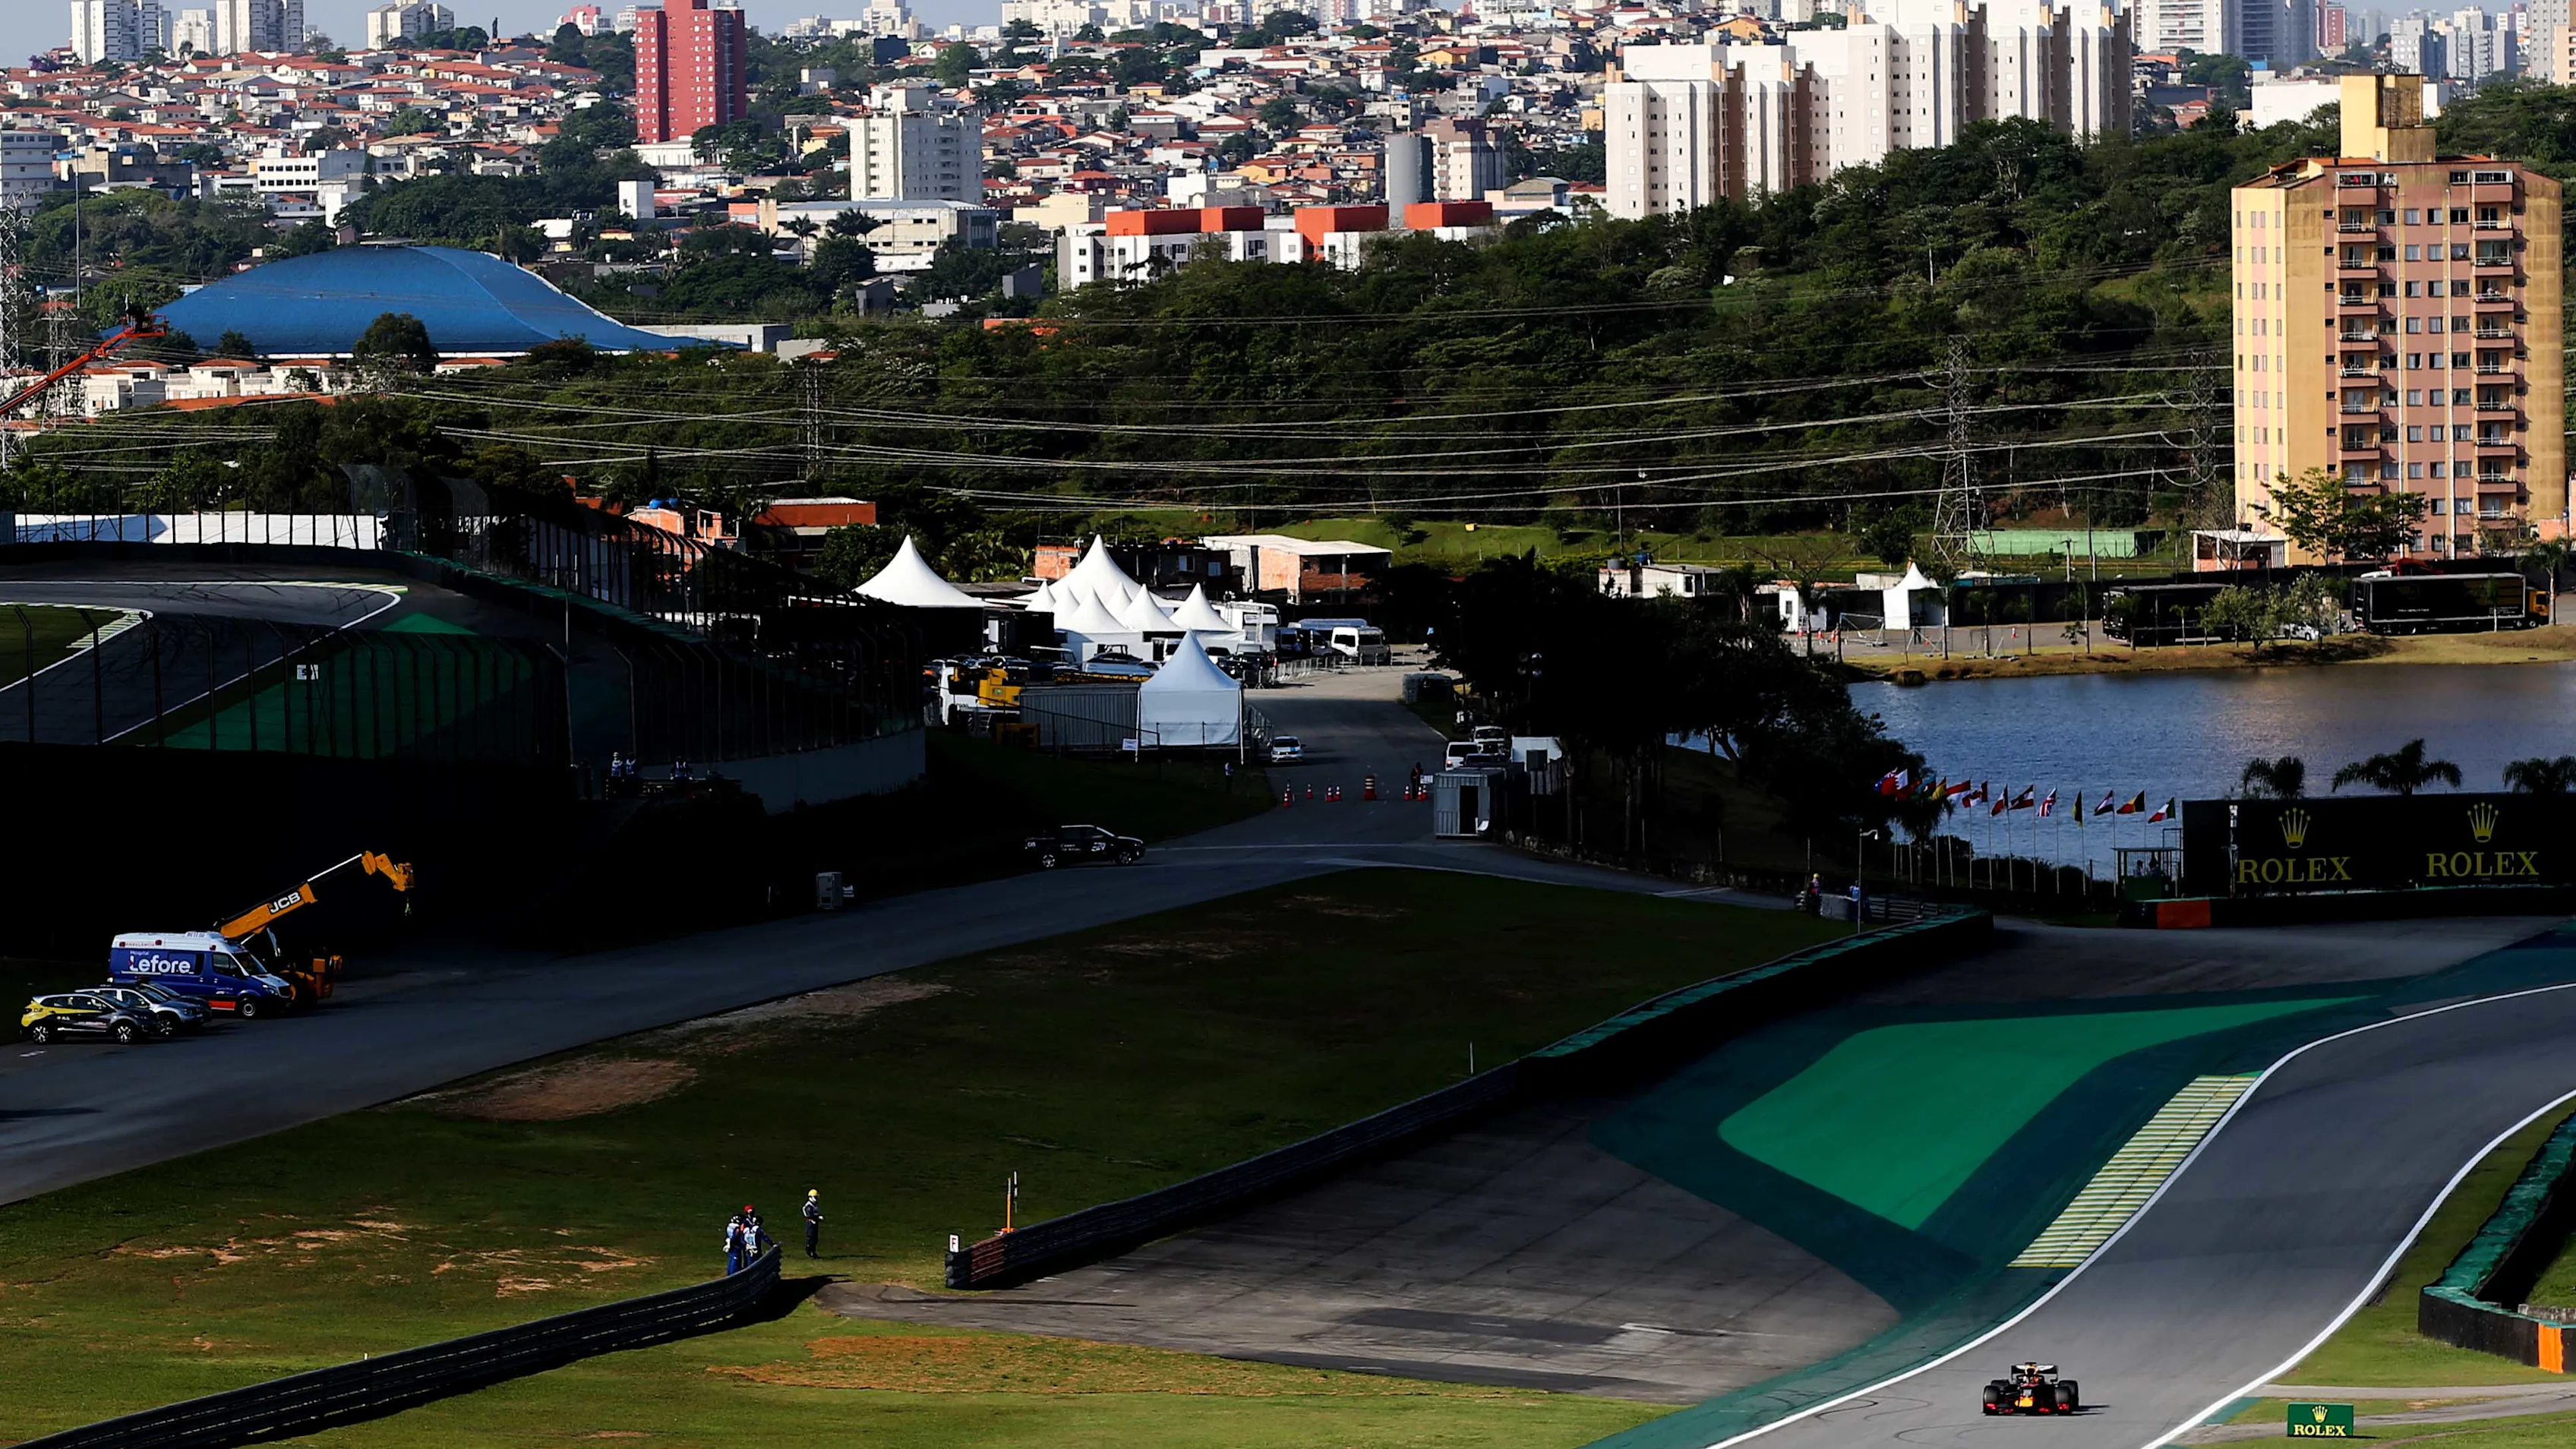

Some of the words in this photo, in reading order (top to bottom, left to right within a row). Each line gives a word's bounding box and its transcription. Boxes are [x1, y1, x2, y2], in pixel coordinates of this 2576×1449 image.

[2237, 856, 2353, 884] ROLEX
[2425, 851, 2540, 878] ROLEX
[270, 892, 301, 913] JCB
[129, 955, 191, 974] Lefore
[2293, 1424, 2347, 1437] ROLEX
